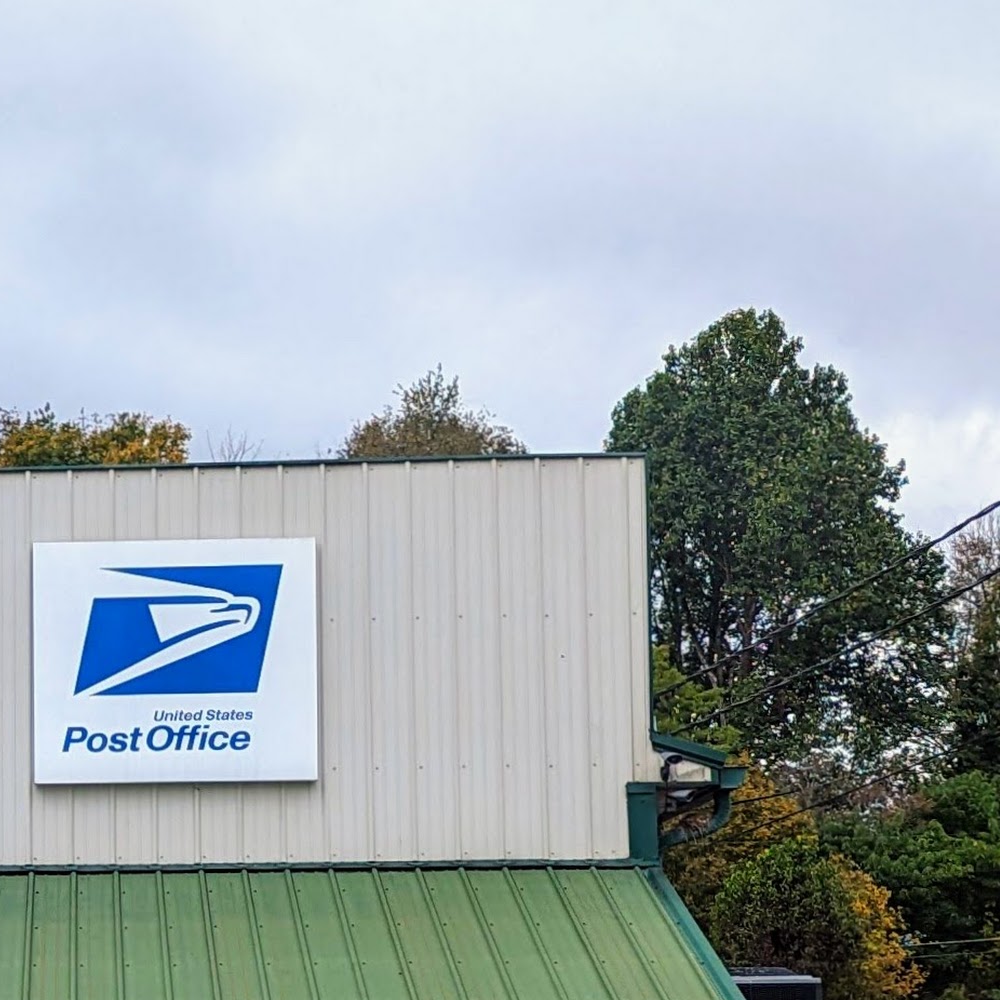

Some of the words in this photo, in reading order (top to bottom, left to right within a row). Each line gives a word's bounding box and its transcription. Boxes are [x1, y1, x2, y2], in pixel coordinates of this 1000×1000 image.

[153, 710, 202, 722] United
[206, 709, 253, 721] States
[61, 727, 143, 753] Post
[146, 725, 251, 752] Office
